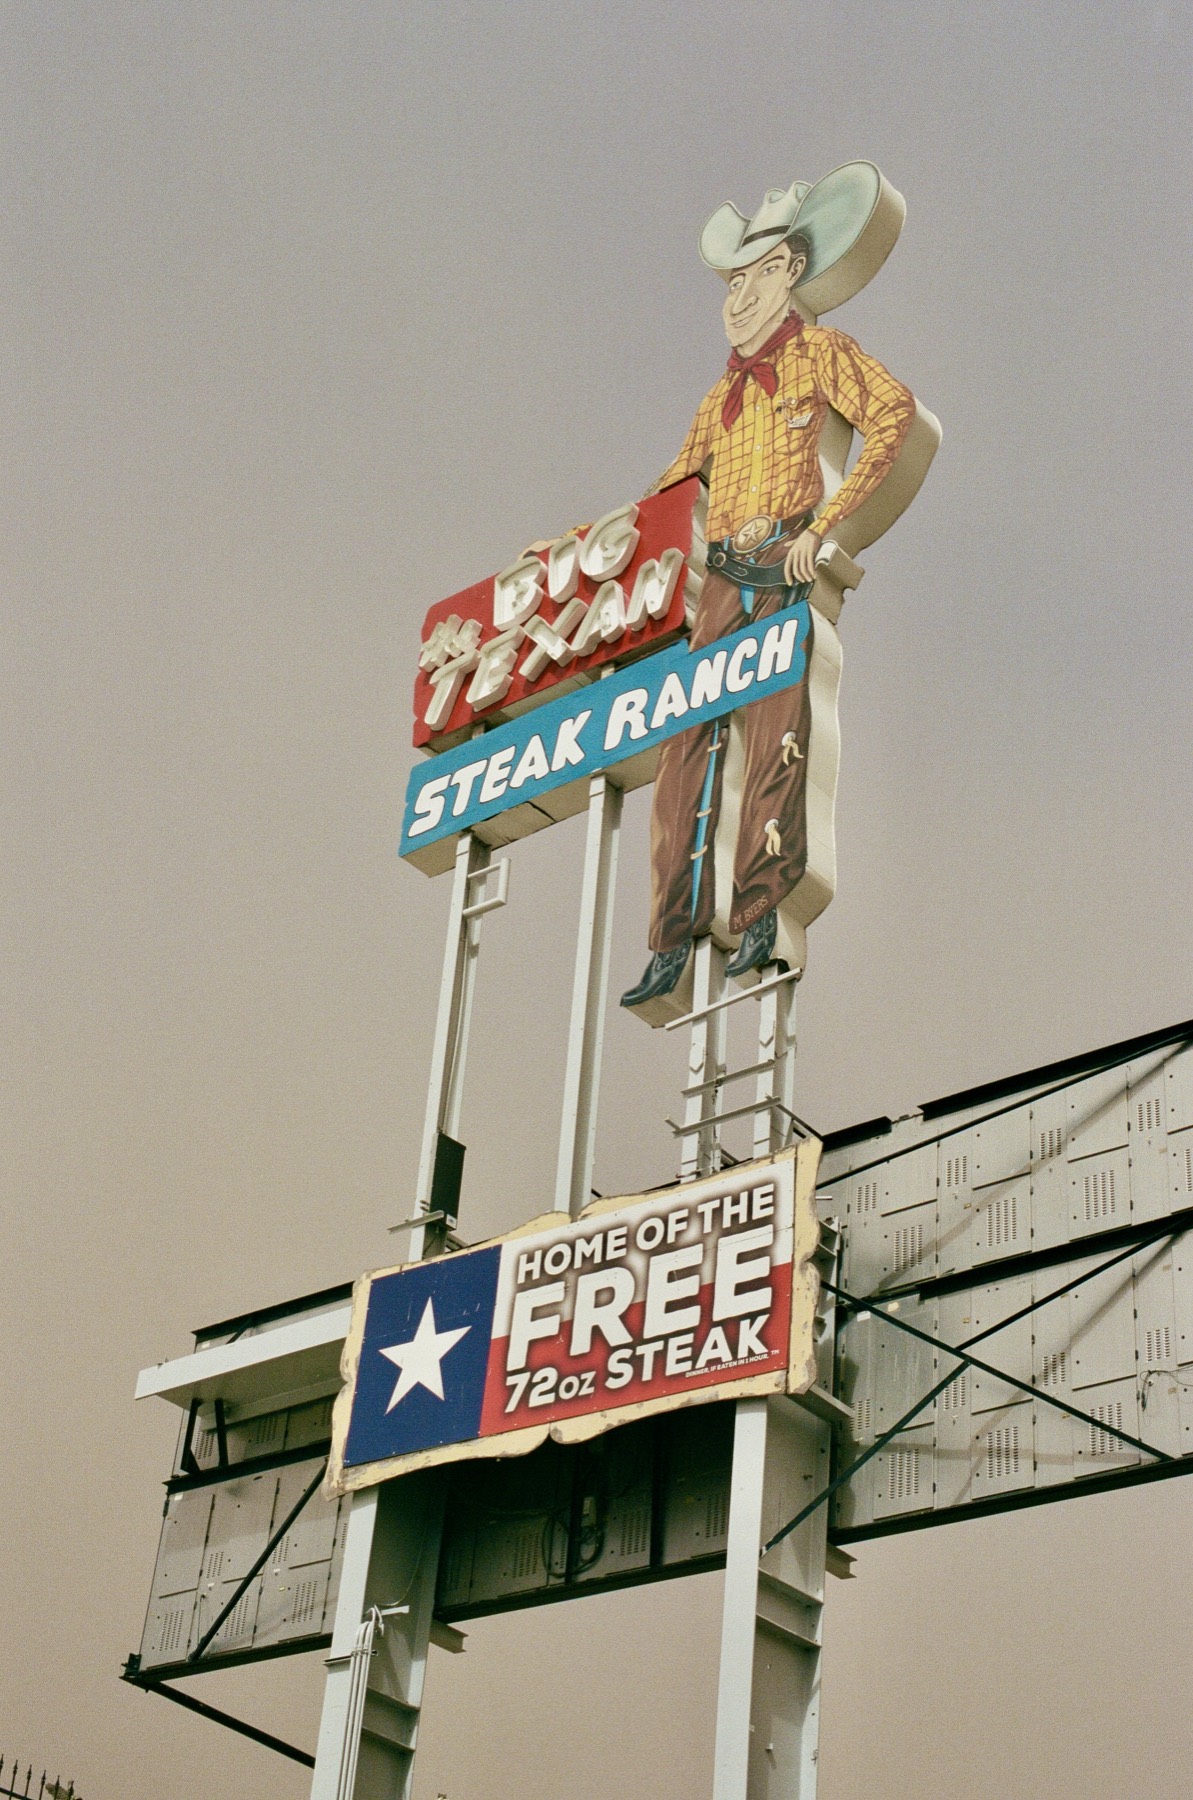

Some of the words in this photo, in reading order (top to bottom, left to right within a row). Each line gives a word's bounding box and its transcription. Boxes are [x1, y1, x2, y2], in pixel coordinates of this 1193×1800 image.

[493, 502, 640, 631] BIG
[424, 548, 685, 731] TEXAN
[408, 710, 593, 838] STEAK
[604, 618, 799, 751] RANCH
[507, 1225, 774, 1371] FREE
[517, 1226, 628, 1285] HOME
[637, 1208, 689, 1252] OF
[697, 1183, 775, 1224] THE
[605, 1314, 770, 1390] STEAK
[716, 1360, 738, 1371] EATEN
